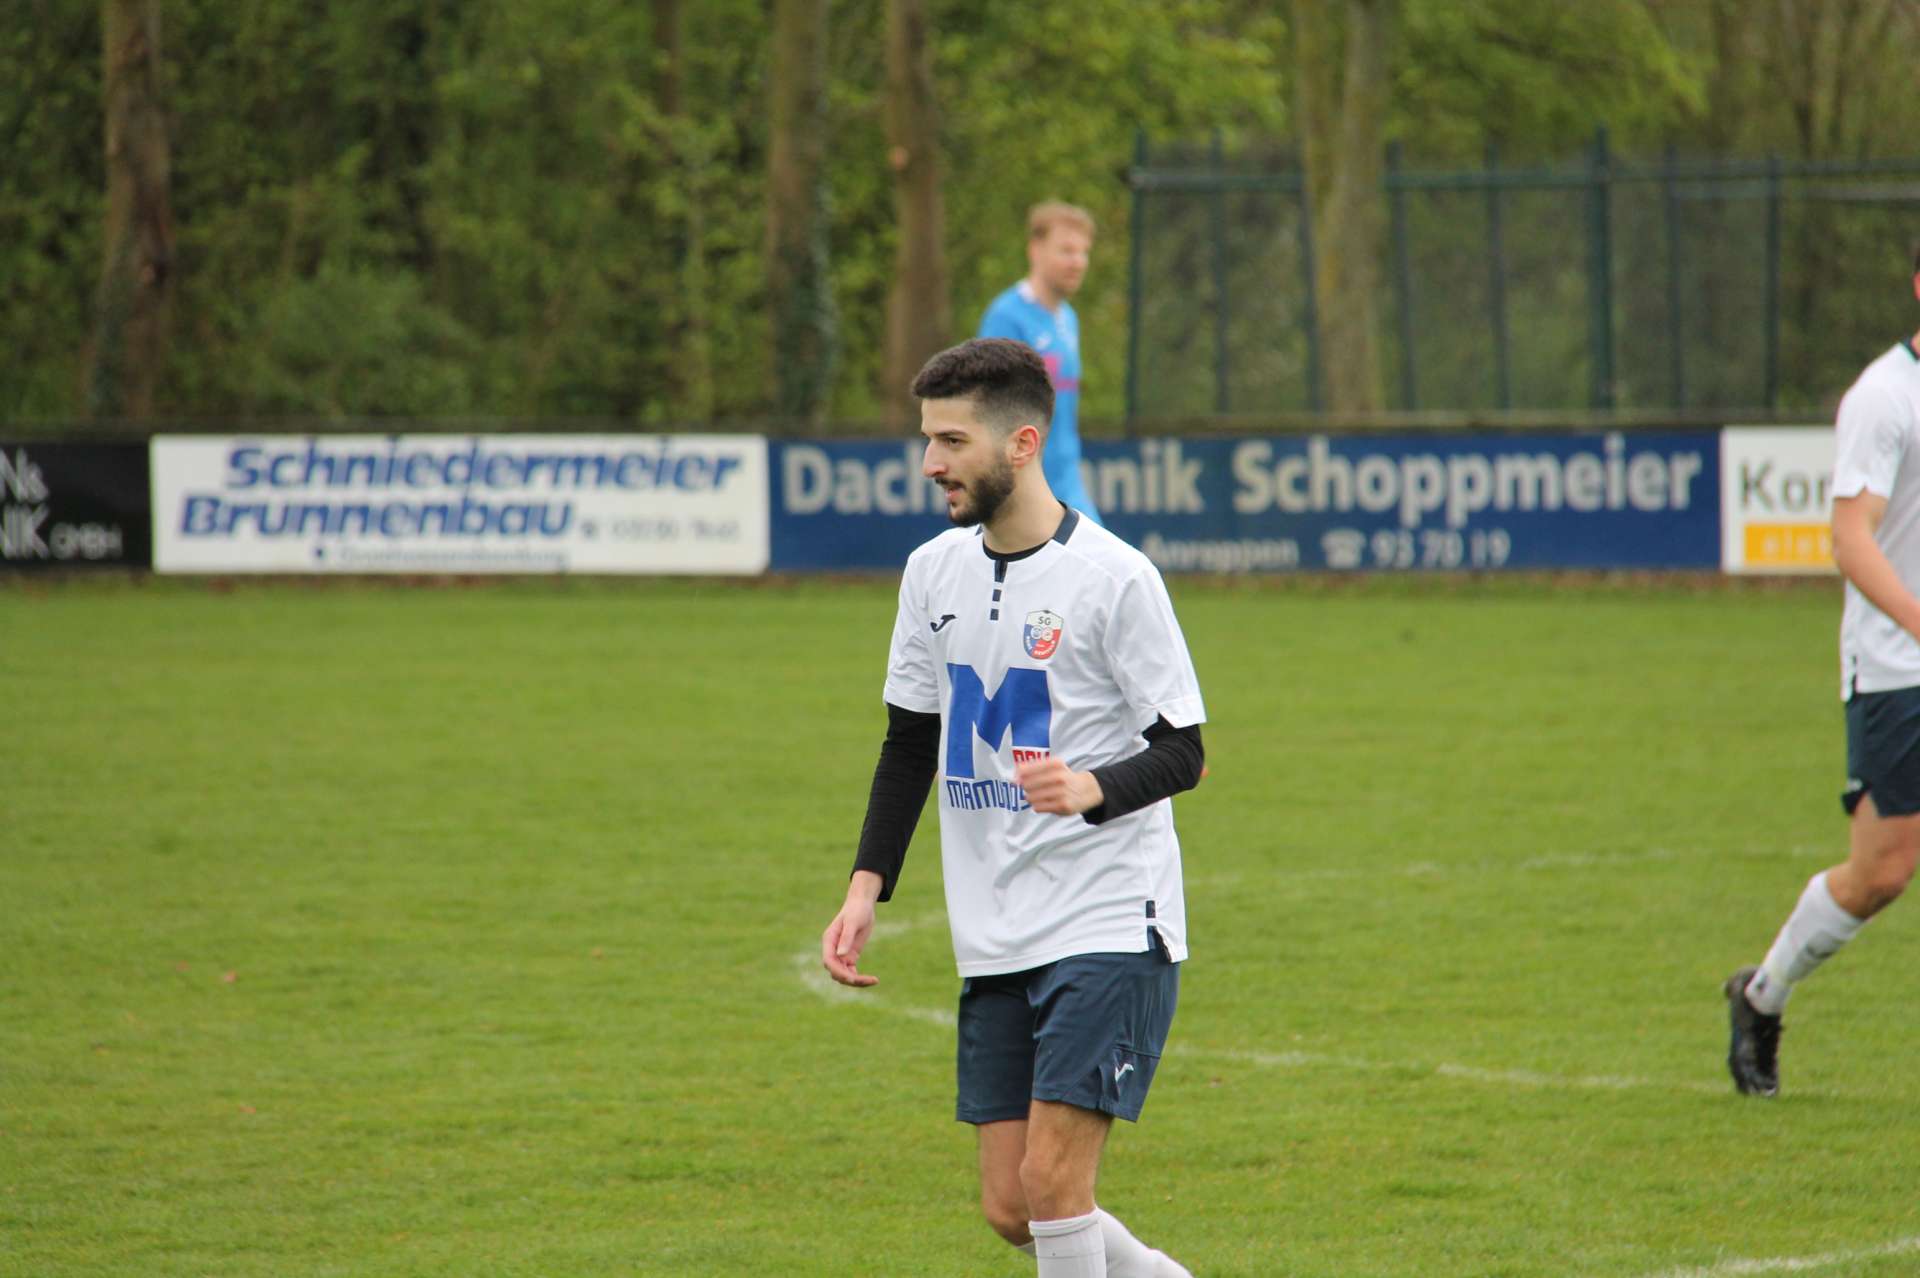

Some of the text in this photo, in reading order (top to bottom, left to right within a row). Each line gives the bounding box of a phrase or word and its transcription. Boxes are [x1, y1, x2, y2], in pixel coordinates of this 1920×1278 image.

[226, 434, 742, 489] Schniedermeier
[782, 433, 1703, 527] Dachnik Schoppmeier
[180, 494, 572, 537] Brunnenbau
[1038, 616, 1052, 626] SG
